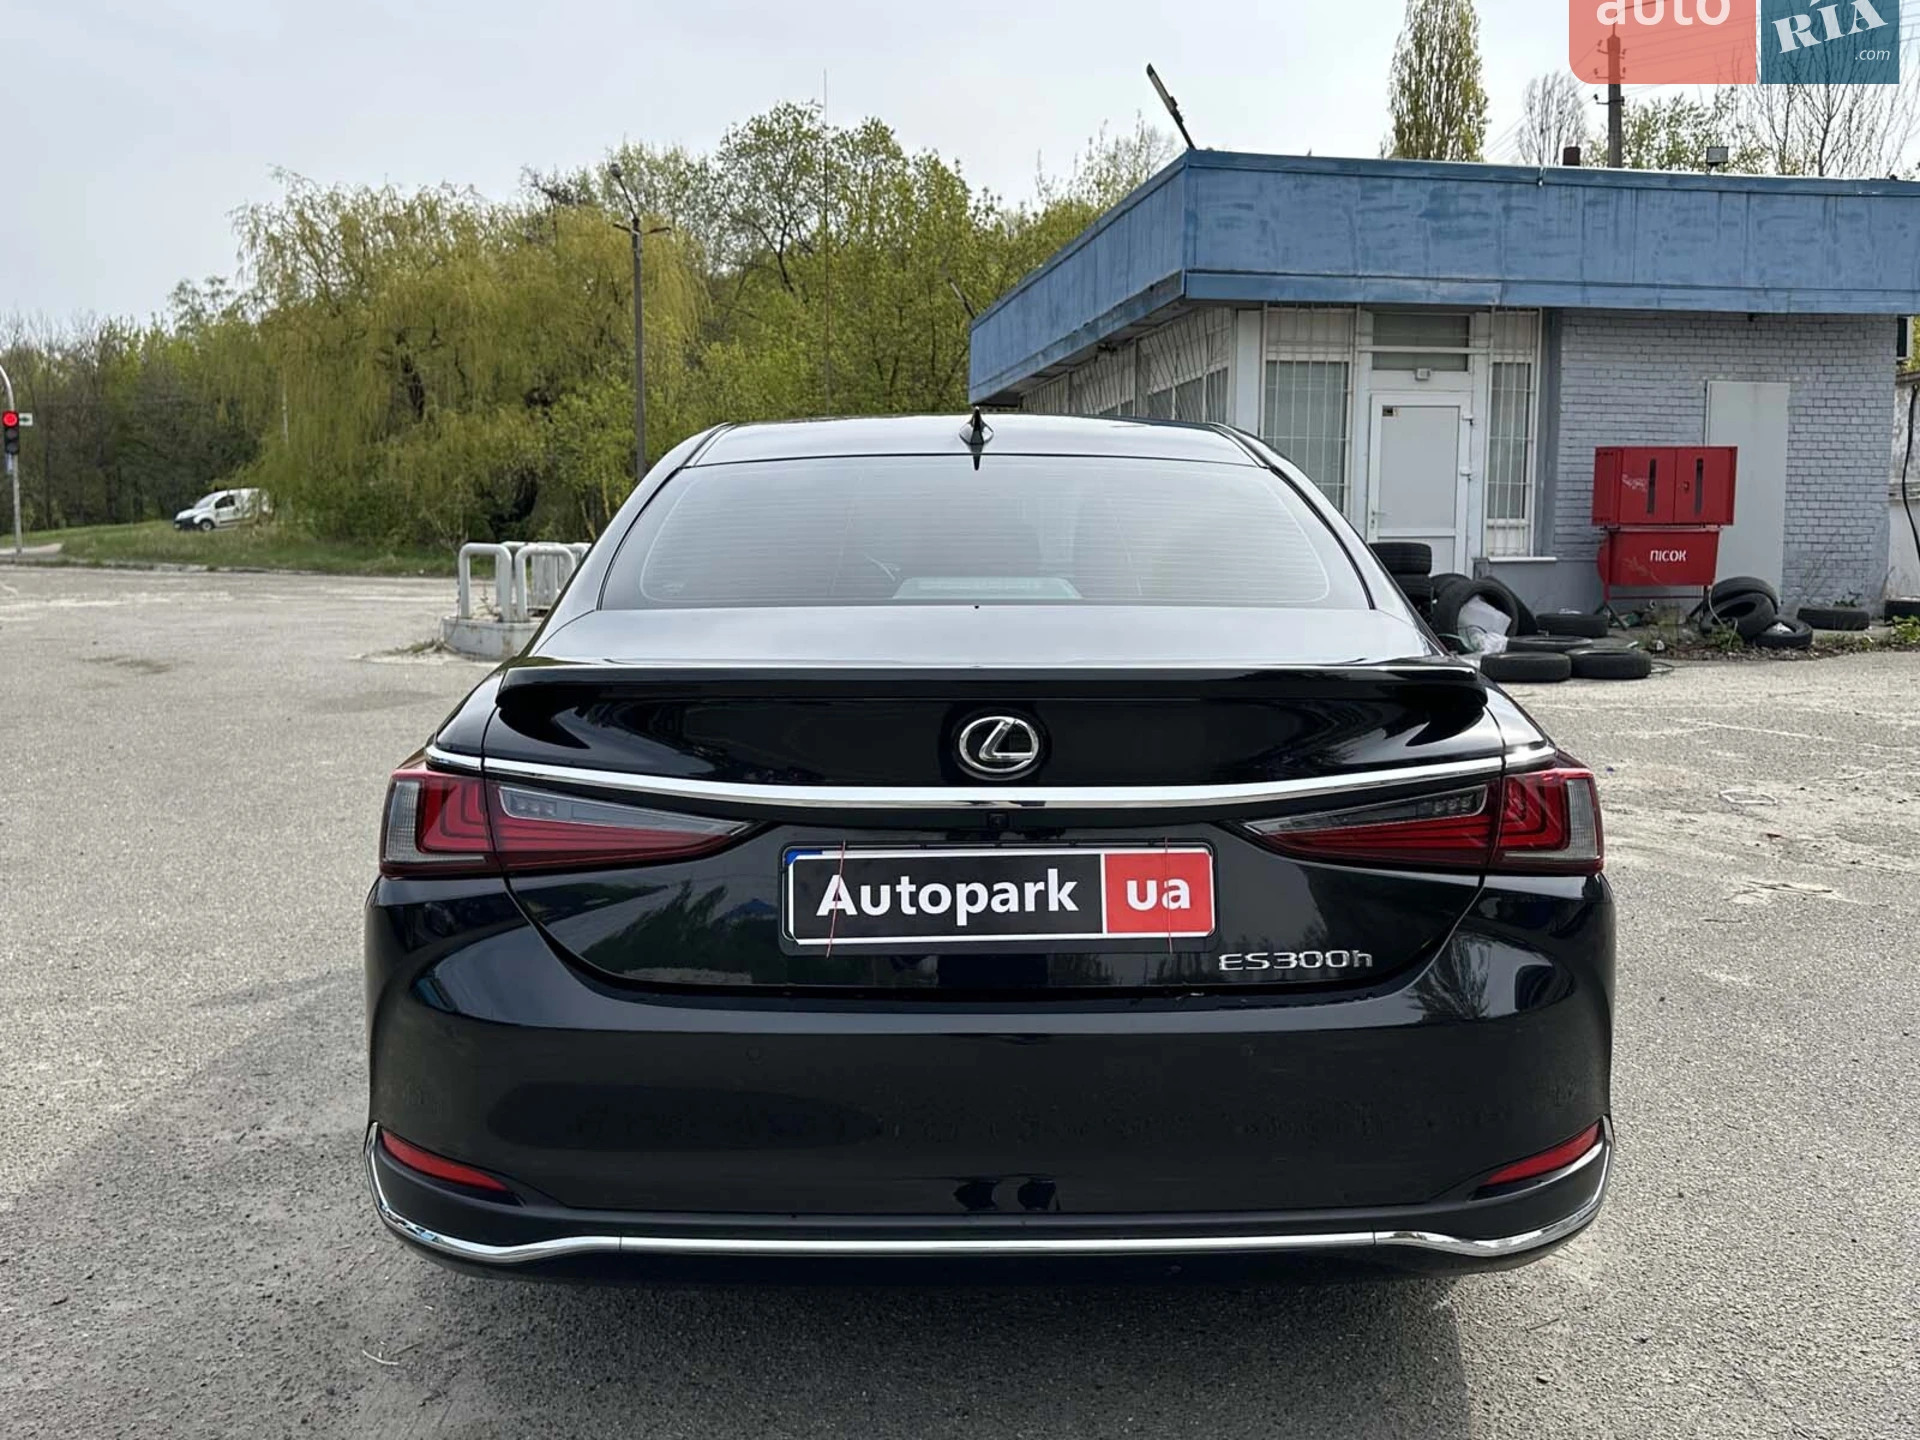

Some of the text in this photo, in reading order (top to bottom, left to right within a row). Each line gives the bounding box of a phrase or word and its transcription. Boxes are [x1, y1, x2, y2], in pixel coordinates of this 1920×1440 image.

[1649, 549, 1687, 562] ПІСОК
[815, 868, 1191, 926] Autopark ua
[1218, 949, 1373, 971] ES300h
